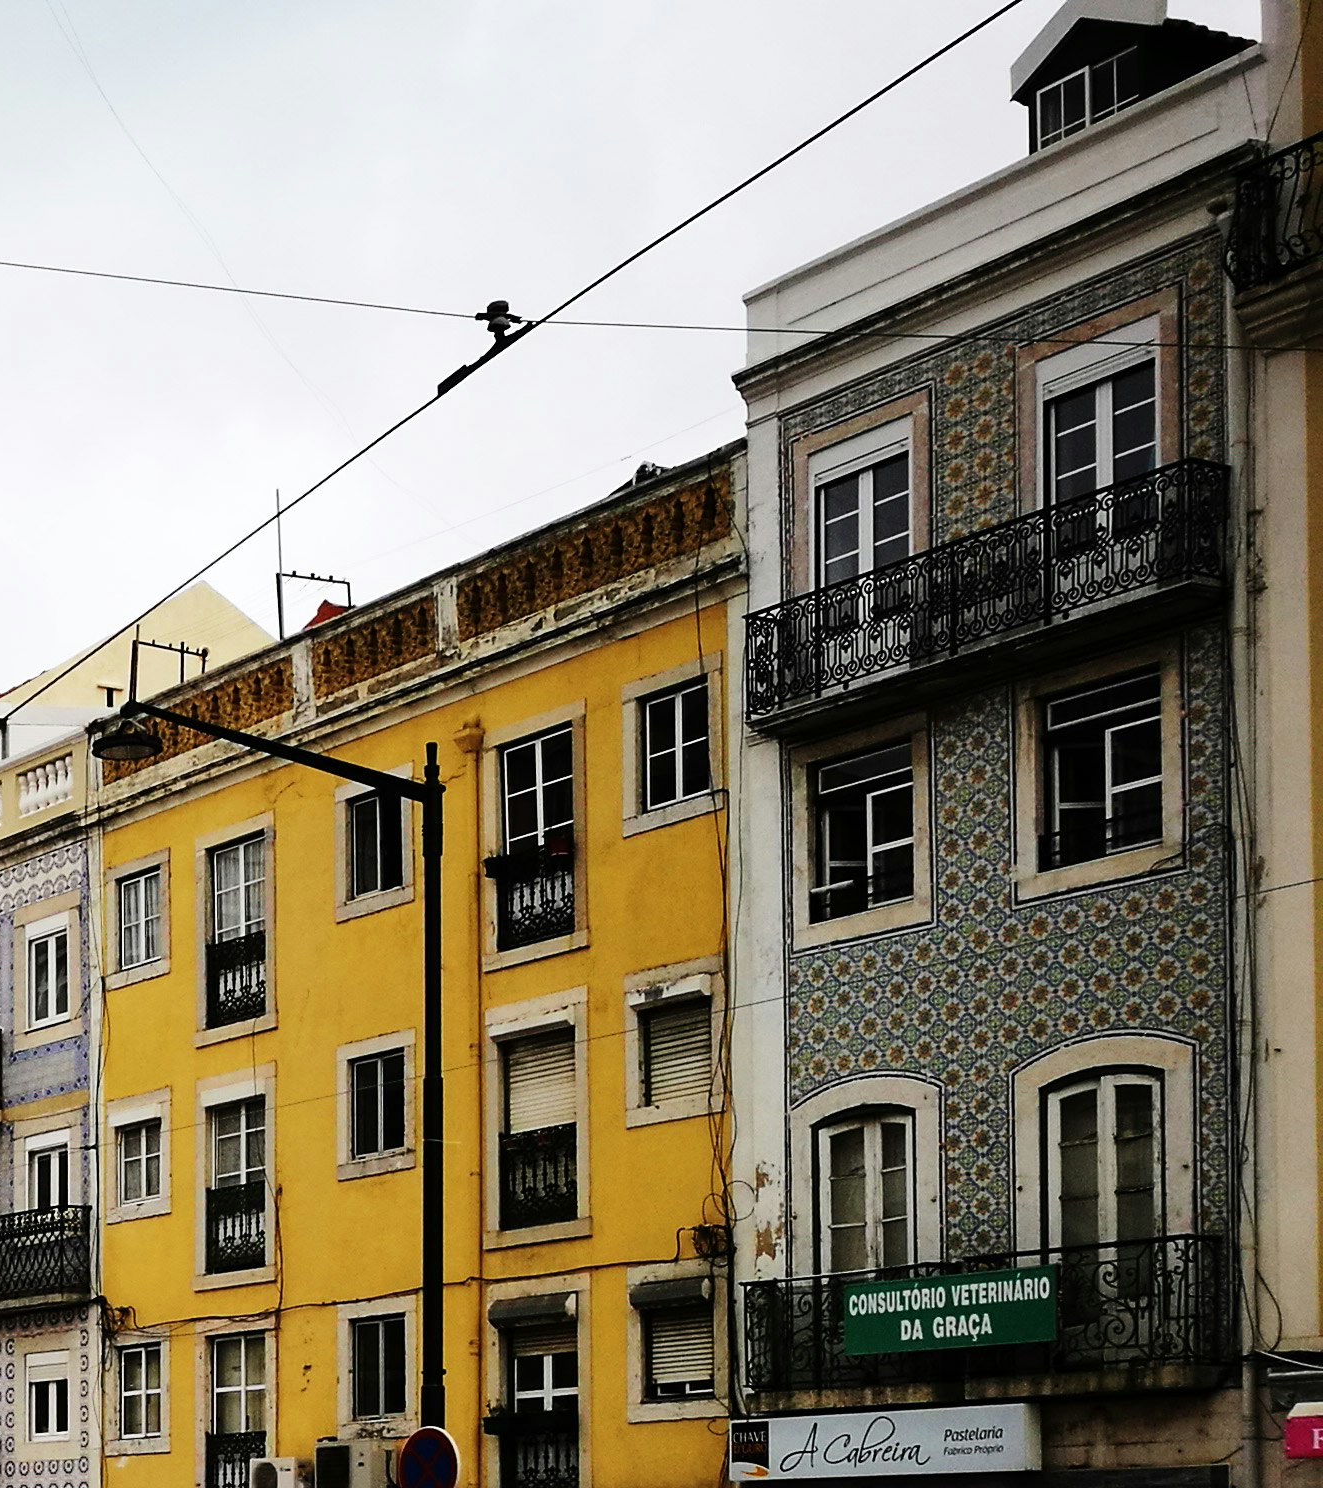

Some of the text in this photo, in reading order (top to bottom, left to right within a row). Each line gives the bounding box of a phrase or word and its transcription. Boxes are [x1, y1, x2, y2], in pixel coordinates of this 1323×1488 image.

[849, 1273, 1051, 1316] CONSULTÓRIO VETERINÁRIO
[900, 1313, 993, 1342] DA GRAÇA
[732, 1431, 767, 1443] CHAVE
[779, 1415, 931, 1473] A Cabreira
[943, 1425, 1004, 1442] Pastelaria
